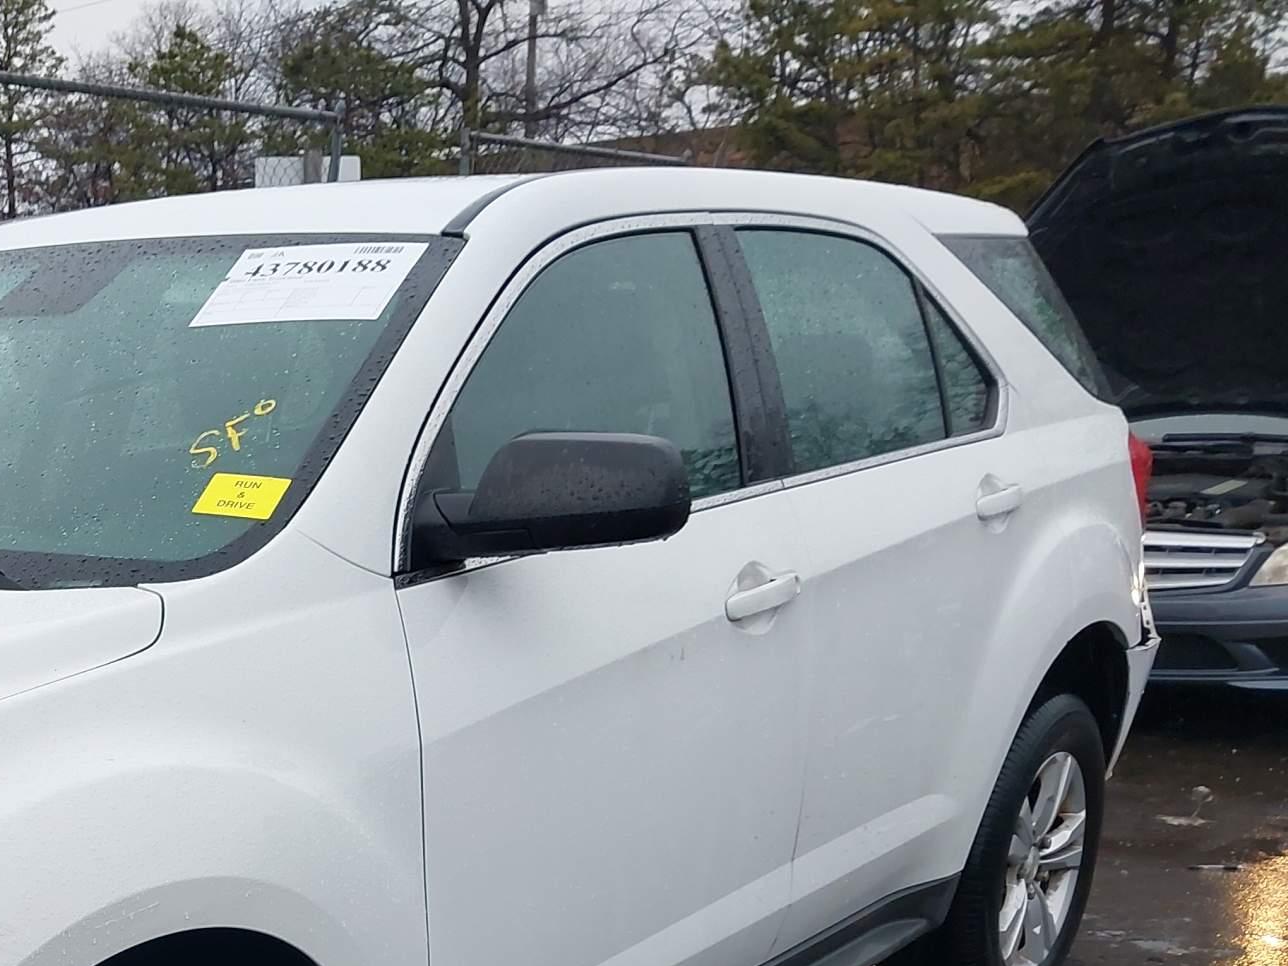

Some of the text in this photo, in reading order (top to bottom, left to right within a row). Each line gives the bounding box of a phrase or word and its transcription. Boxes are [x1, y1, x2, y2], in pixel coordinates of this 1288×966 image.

[244, 258, 392, 279] 43780188
[234, 480, 263, 490] RUN
[236, 491, 246, 499] &
[216, 499, 256, 511] DRIVE
